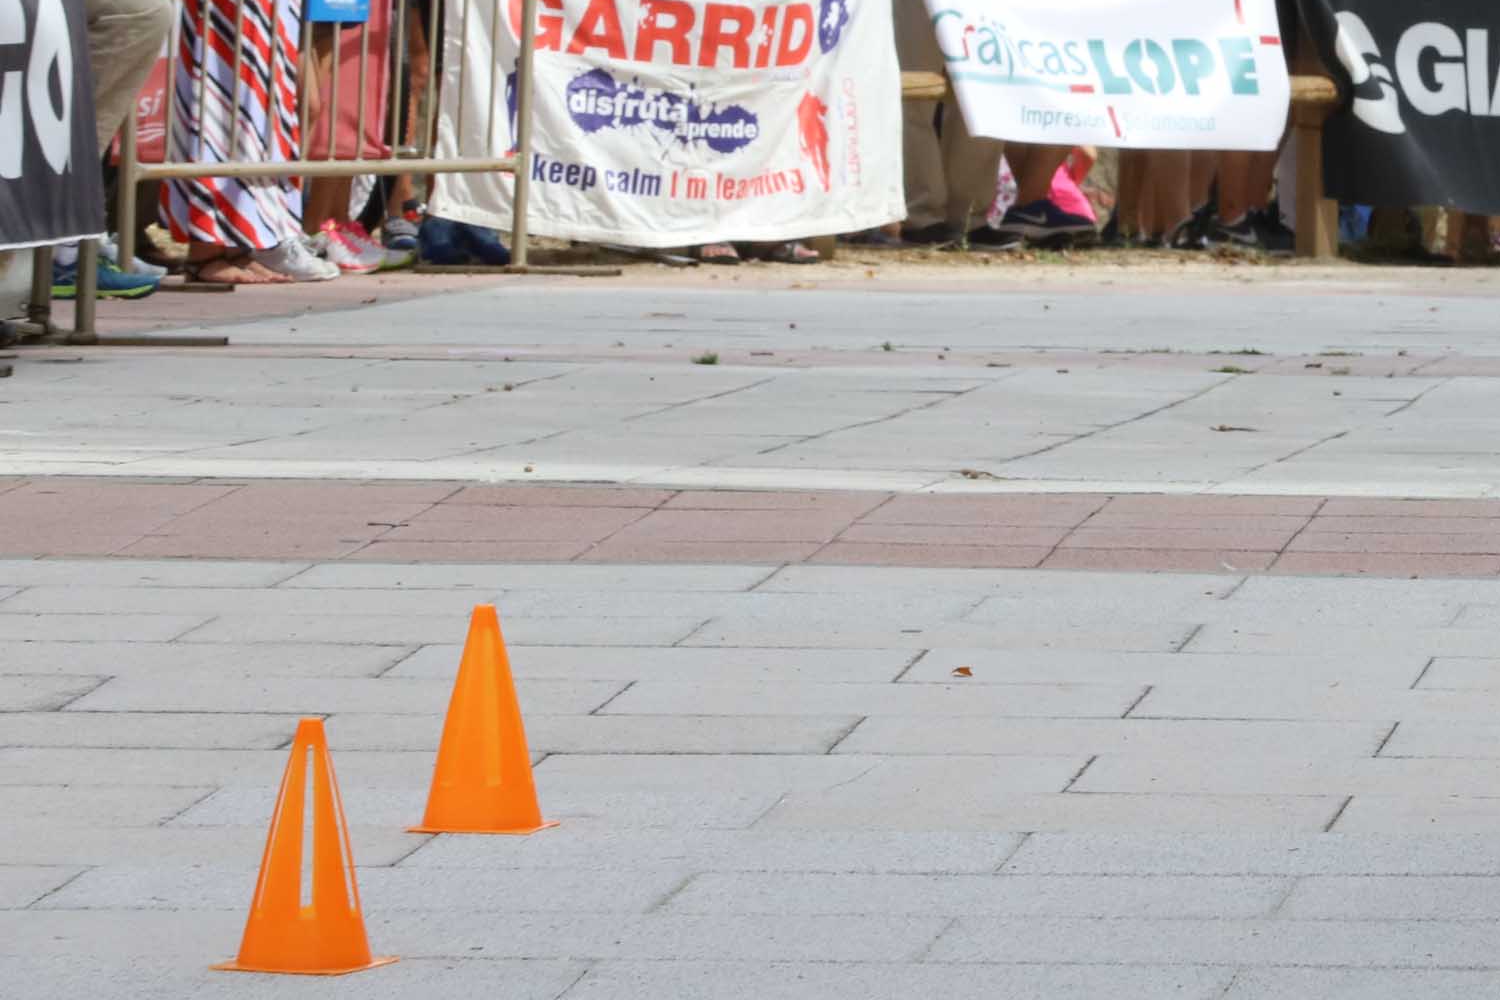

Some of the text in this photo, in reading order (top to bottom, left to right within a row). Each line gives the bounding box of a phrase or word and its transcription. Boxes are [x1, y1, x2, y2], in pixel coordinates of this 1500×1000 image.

[1088, 37, 1259, 95] LOPE
[568, 88, 689, 122] disfruta
[674, 116, 758, 141] aprende
[531, 153, 597, 192] keep
[604, 167, 661, 197] calm
[715, 167, 807, 200] learning
